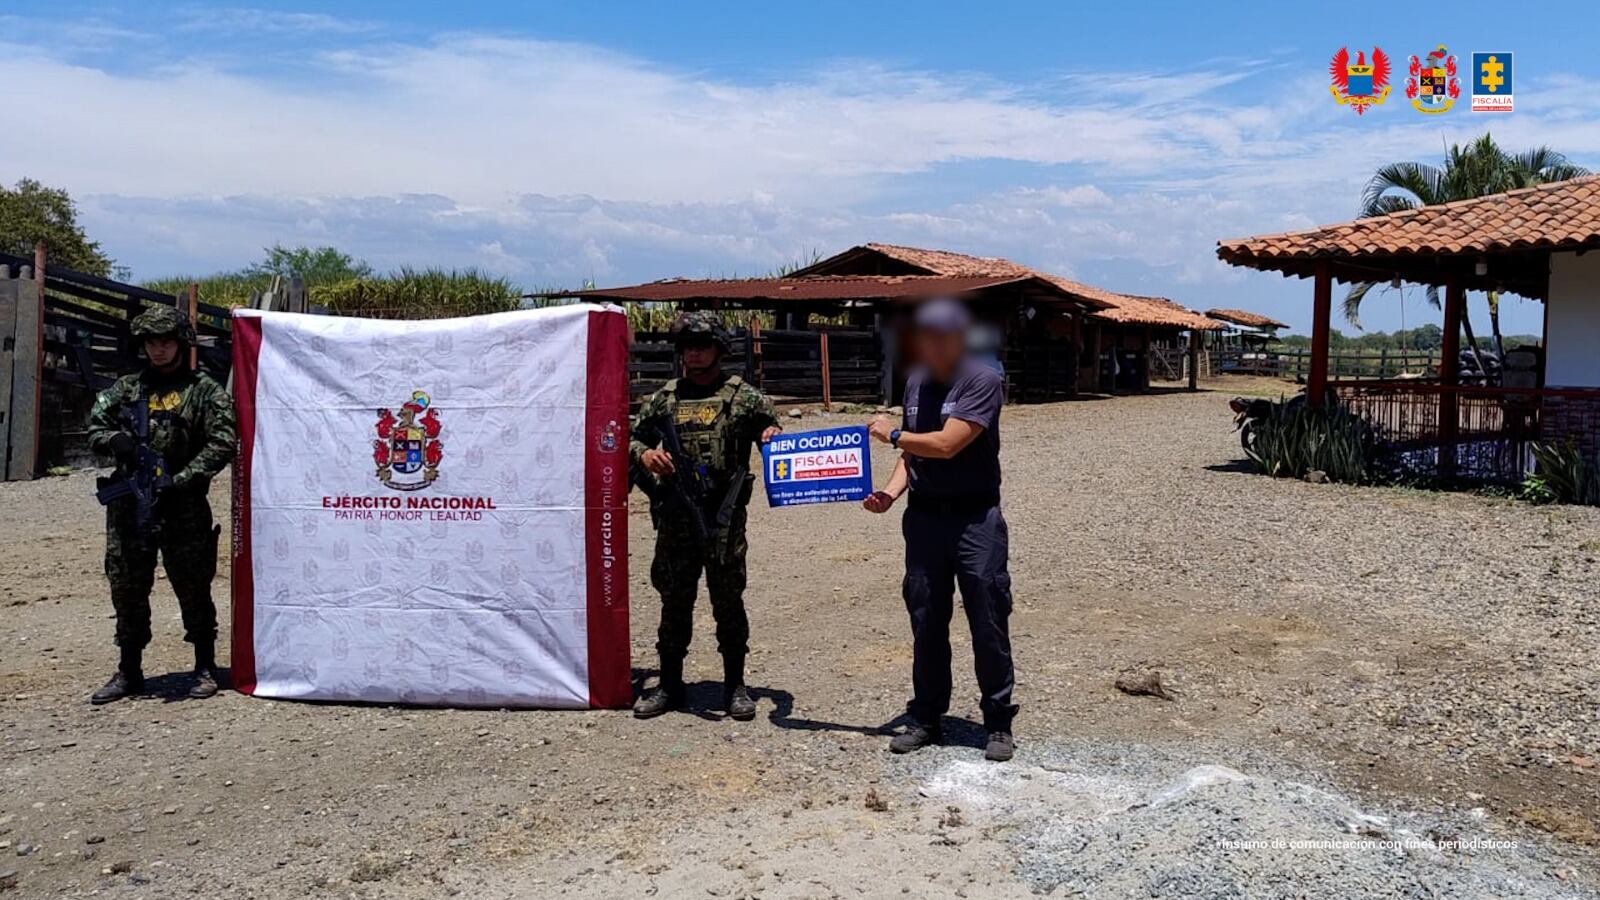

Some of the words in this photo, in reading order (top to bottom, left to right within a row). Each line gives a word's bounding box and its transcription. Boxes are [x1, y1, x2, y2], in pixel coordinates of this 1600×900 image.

[770, 439, 796, 452] BIEN
[799, 433, 862, 449] OCUPADO
[794, 453, 858, 467] FISCALÍA
[322, 494, 401, 509] EJÉRCITO
[407, 497, 497, 509] NACIONAL
[335, 510, 374, 520] PATRIA
[380, 511, 423, 521] HONOR
[430, 511, 483, 521] LEALTAD
